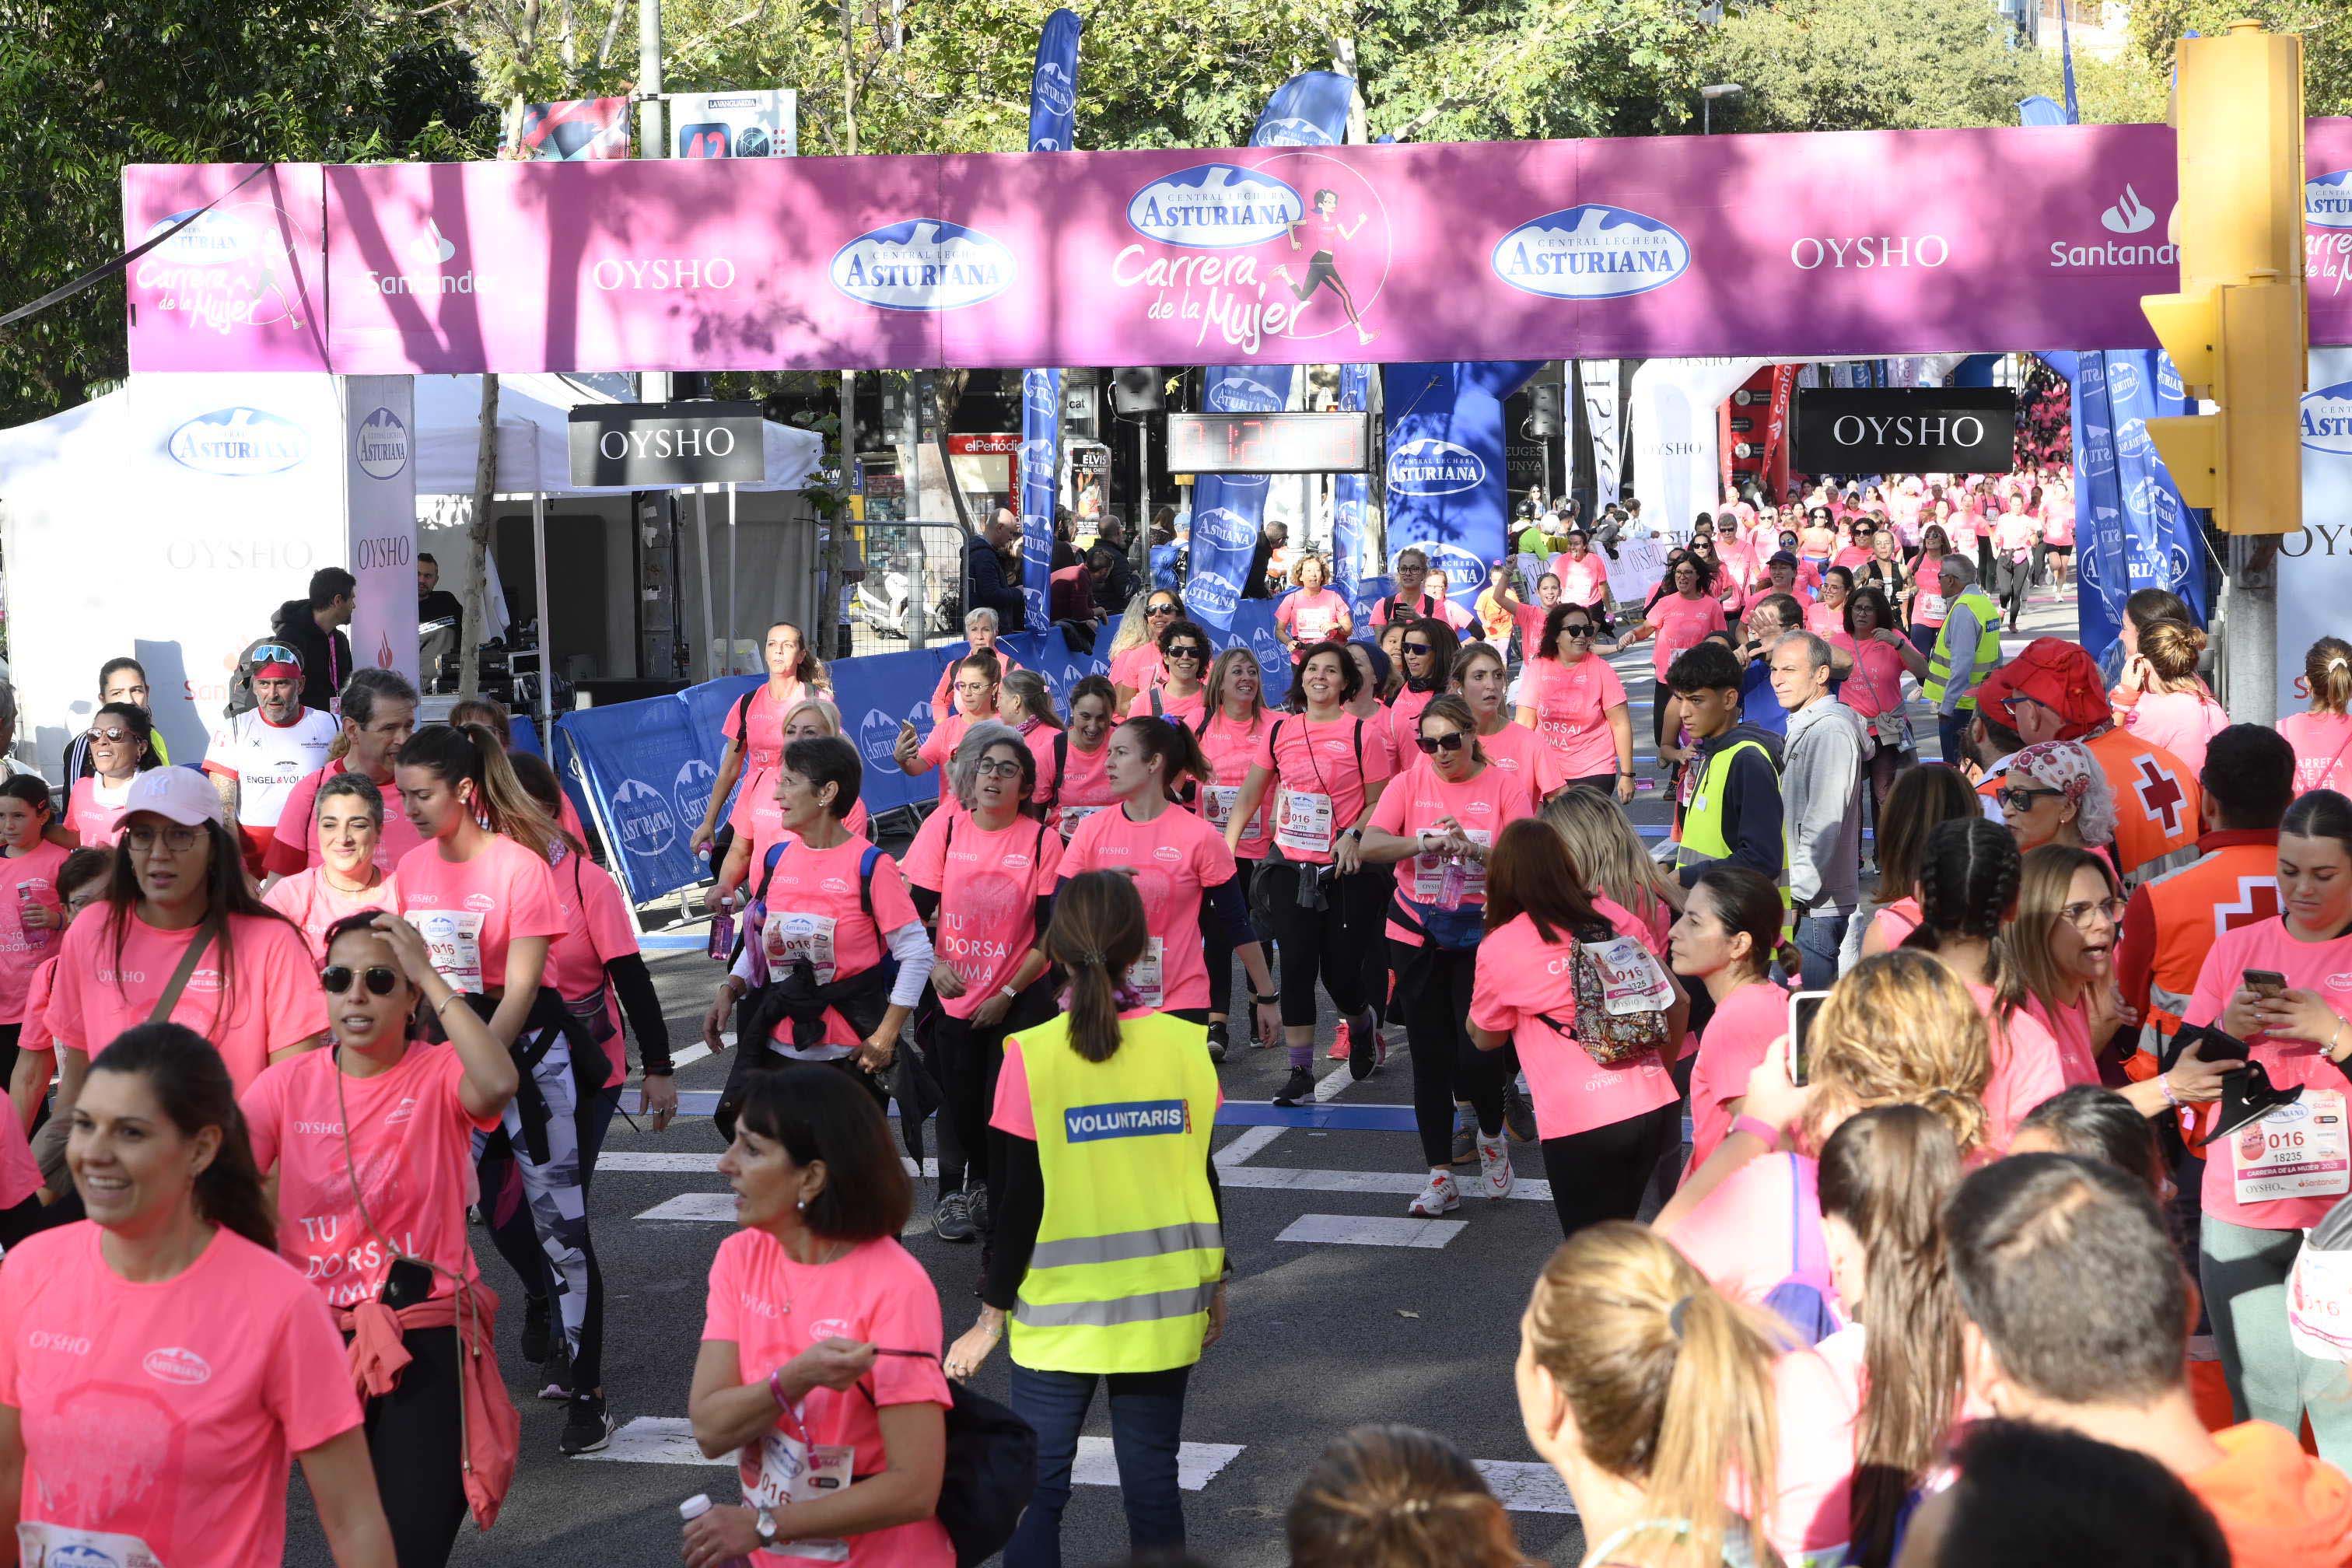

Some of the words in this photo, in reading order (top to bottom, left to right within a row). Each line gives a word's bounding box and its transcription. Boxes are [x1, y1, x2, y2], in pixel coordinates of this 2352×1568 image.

[1141, 197, 1289, 227] ASTURIANA
[1538, 238, 1599, 247] CENTRAL
[1605, 237, 1668, 246] LECHERA
[1508, 243, 1675, 275] ASTURIANA
[1790, 235, 1948, 269] OYSHO
[593, 259, 735, 290] OYSHO
[845, 257, 999, 287] ASTURIANA
[1112, 245, 1257, 287] Carrera
[2323, 260, 2335, 277] la
[363, 271, 496, 295] Santander
[159, 292, 177, 310] de
[1148, 297, 1172, 320] de
[1181, 296, 1199, 320] la
[1196, 282, 1312, 355] Mujer
[1833, 415, 1984, 448] OYSHO
[361, 439, 405, 461] ASTURIANA
[600, 427, 734, 460] OYSHO
[1643, 441, 1702, 455] OYSHO
[1083, 455, 1107, 464] ELVIS
[1391, 463, 1478, 482] ASTURIANA
[359, 536, 409, 569] OYSHO
[1628, 545, 1662, 572] OYSHO
[1292, 814, 1310, 823] 016
[947, 852, 977, 861] OYSHO
[1099, 845, 1129, 856] OYSHO
[946, 913, 961, 930] TU
[432, 943, 454, 955] 016
[786, 940, 810, 950] 016
[1616, 967, 1643, 981] 016
[1586, 1074, 1622, 1090] OYSHO
[293, 1122, 346, 1134] OYSHO
[1069, 1109, 1181, 1134] VOLUNTARIS
[2269, 1132, 2305, 1148] 016
[2274, 1152, 2302, 1163] 18235
[2246, 1183, 2280, 1194] OYSHO
[2305, 1178, 2341, 1187] Santander
[300, 1216, 336, 1242] TU
[306, 1232, 420, 1278] DORSAL
[30, 1330, 90, 1356] OYSHO
